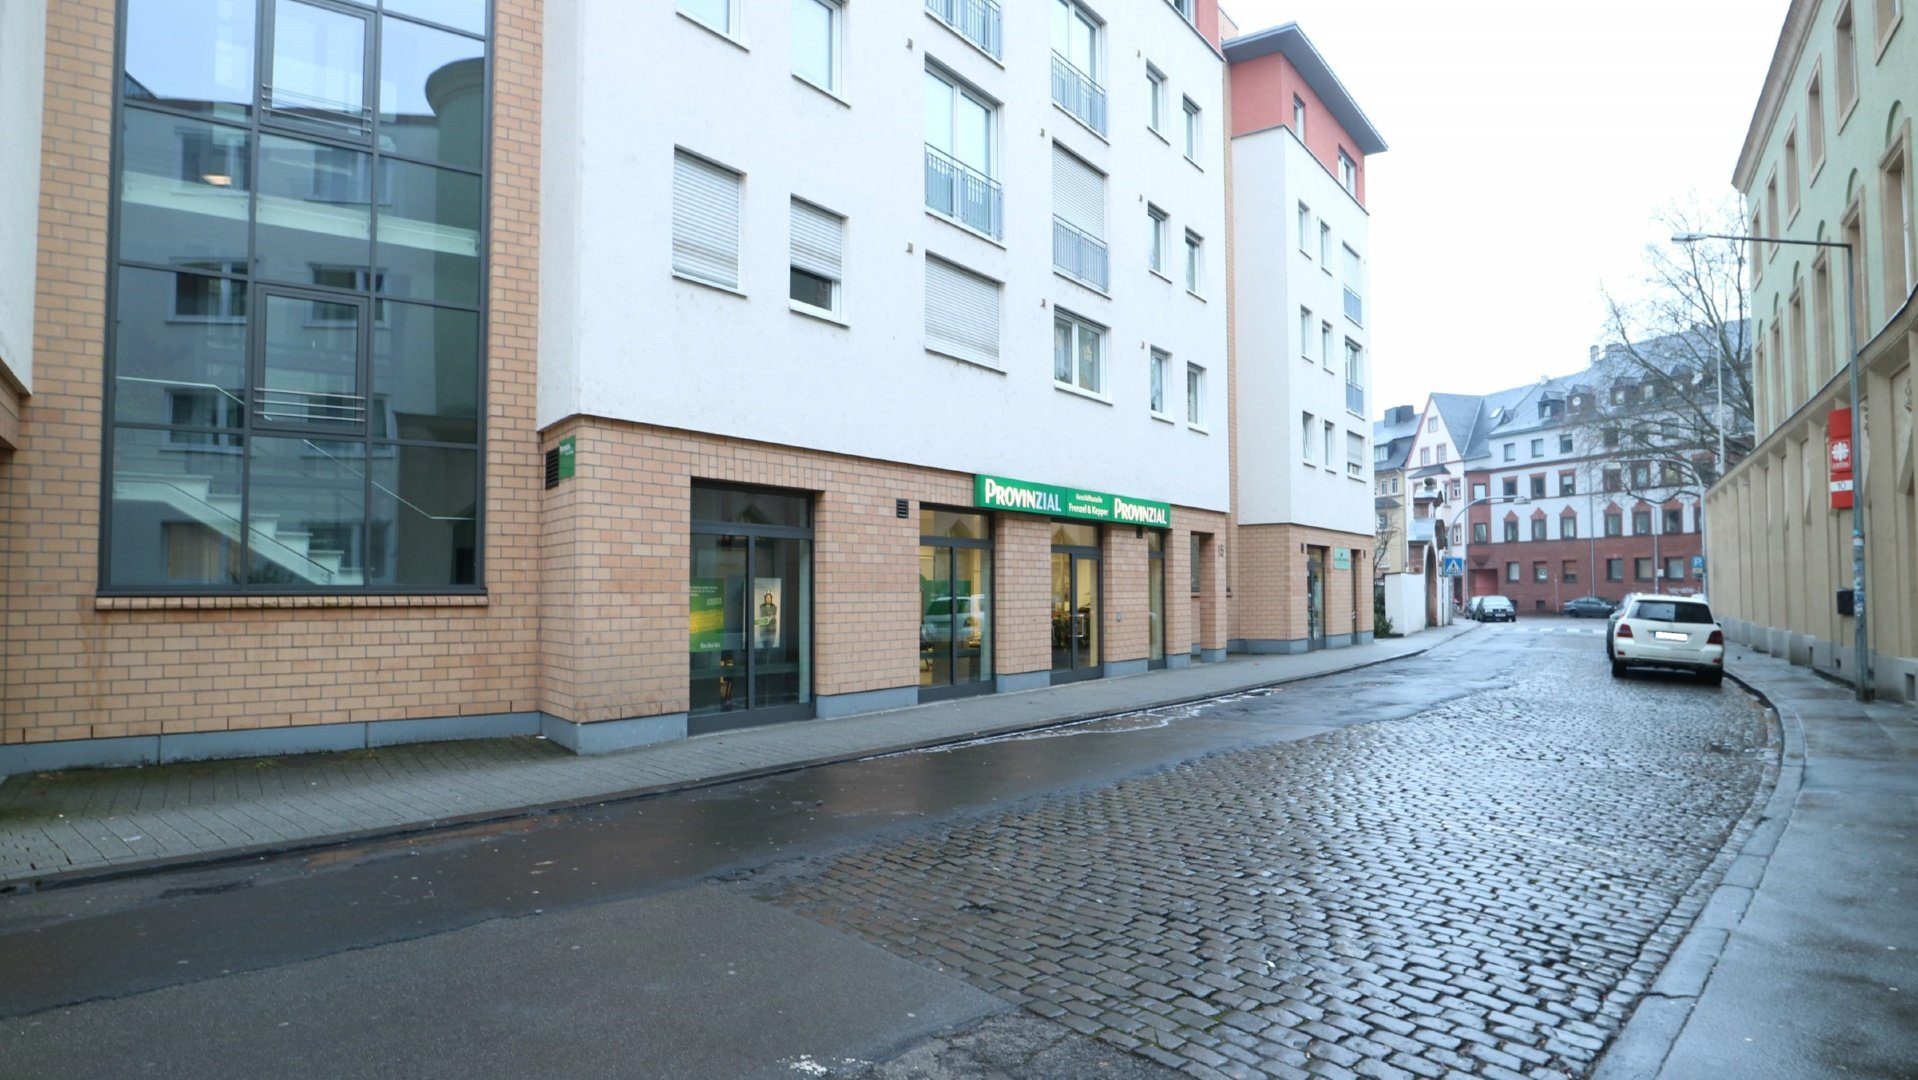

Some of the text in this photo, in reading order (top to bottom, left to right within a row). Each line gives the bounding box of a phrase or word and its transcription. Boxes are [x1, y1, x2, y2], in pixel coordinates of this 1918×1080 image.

[985, 478, 1061, 511] PROVINZIAL
[1837, 482, 1847, 490] 10
[1114, 497, 1167, 525] PROVINZIAL
